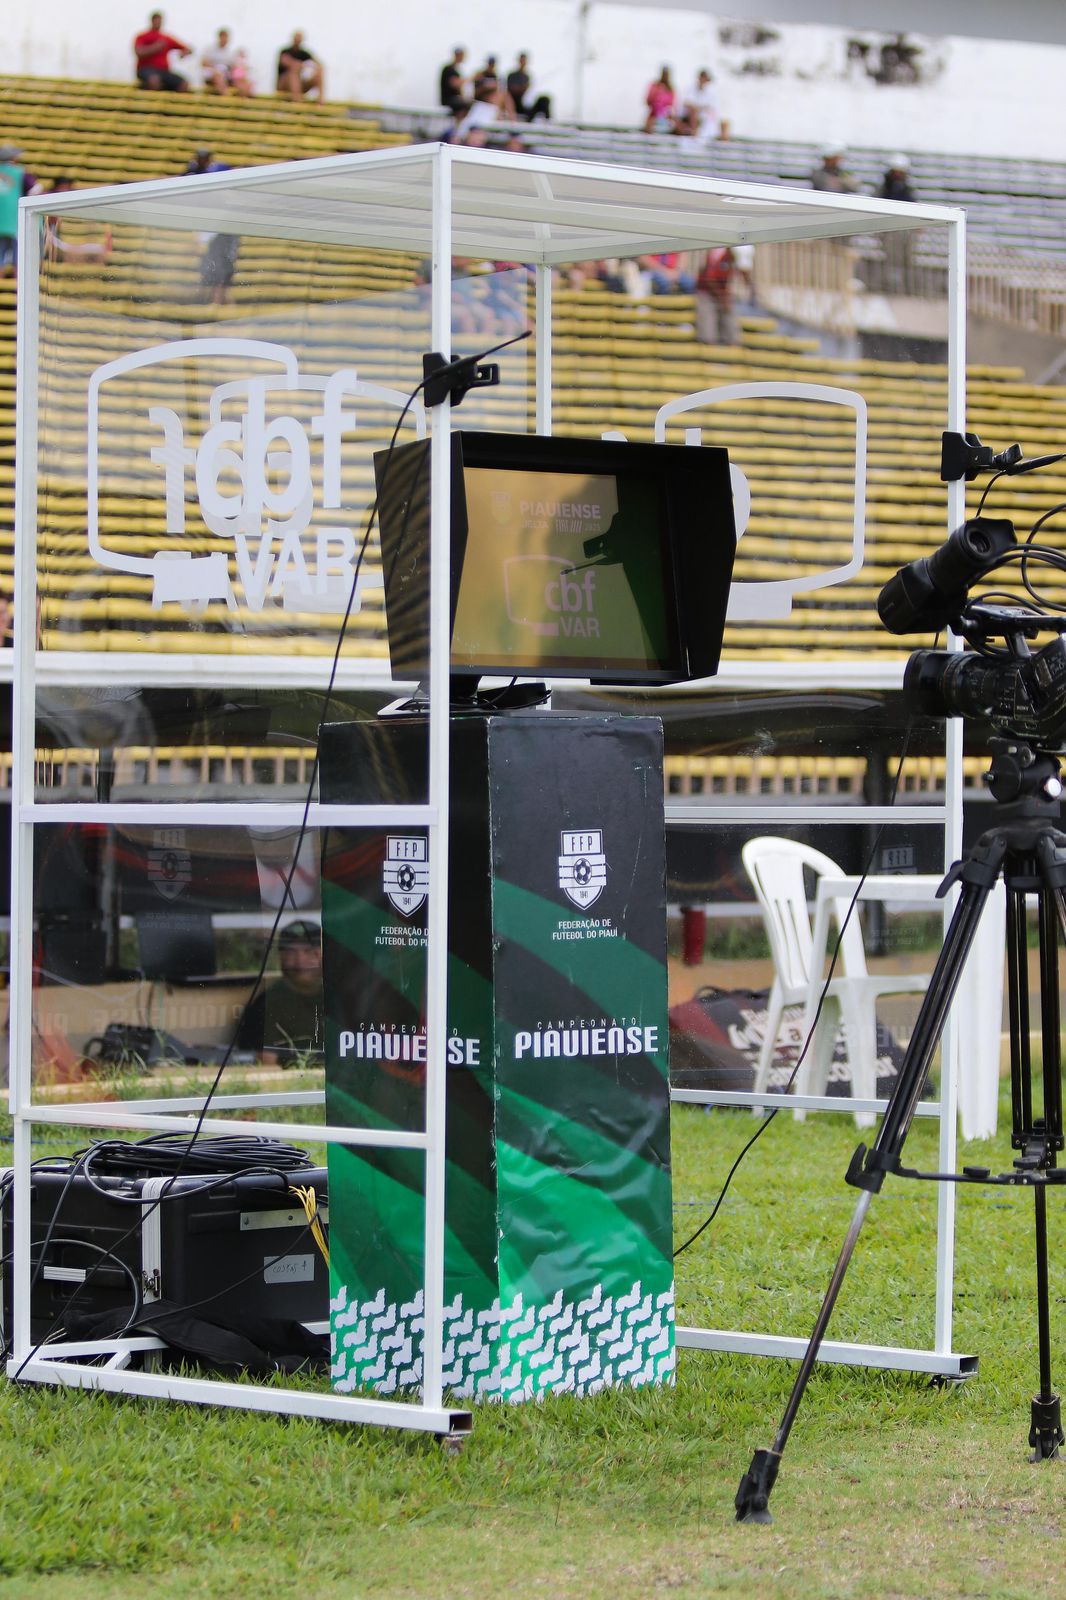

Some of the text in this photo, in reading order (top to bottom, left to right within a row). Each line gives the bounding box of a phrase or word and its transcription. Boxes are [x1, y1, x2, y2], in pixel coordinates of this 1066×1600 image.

[520, 501, 601, 519] PIAUIENSE
[235, 528, 356, 601] VAR
[544, 570, 596, 612] cbf
[560, 617, 600, 637] VAR
[396, 842, 418, 858] FFP
[571, 836, 593, 852] FFP
[381, 926, 422, 937] FEDERAÇÃO
[558, 918, 612, 930] FEDERAÇÃO DE
[375, 936, 406, 946] FUTEBOL
[408, 938, 419, 946] DO
[552, 926, 618, 940] FUTEBOL DO PIAUÍ
[359, 1022, 458, 1037] CAMPEONO
[537, 1017, 637, 1030] CAMPEONATO
[339, 1030, 481, 1065] PIAUIESE
[515, 1026, 659, 1059] PIAUIENSE
